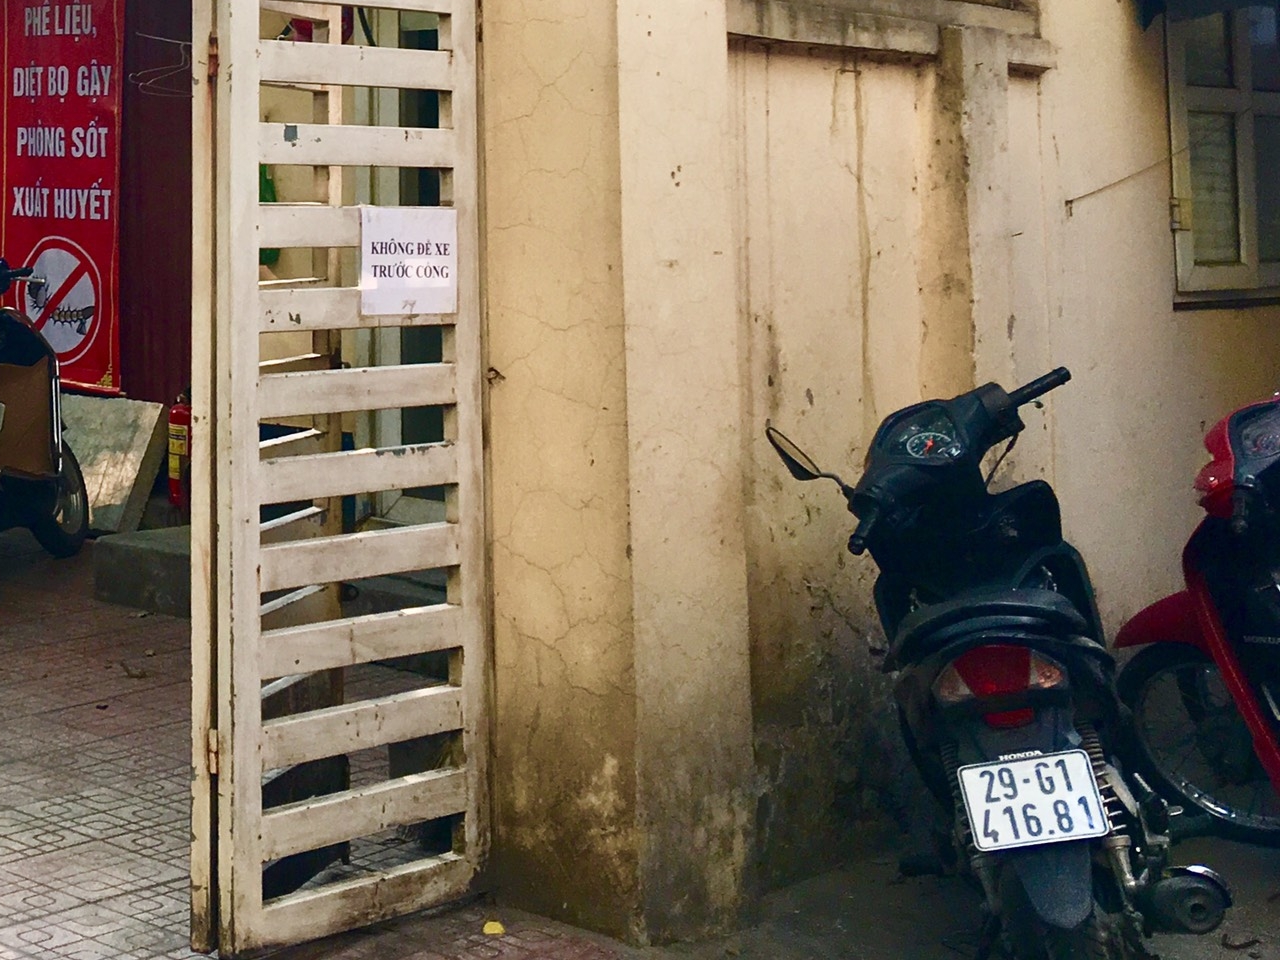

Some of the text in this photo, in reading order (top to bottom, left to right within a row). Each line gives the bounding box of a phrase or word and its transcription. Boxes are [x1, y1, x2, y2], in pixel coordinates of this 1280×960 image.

[13, 59, 112, 104] DIỆT BỌ GẬY
[16, 116, 109, 158] PHÒNG SỐT
[12, 176, 112, 220] XUẤT HUYẾT
[370, 238, 414, 255] KHÔNG
[435, 243, 450, 256] XE
[371, 261, 414, 278] TRƯỚC
[998, 750, 1044, 761] HONDA
[979, 759, 1073, 803] 29-G1
[983, 796, 1095, 843] 416.81
